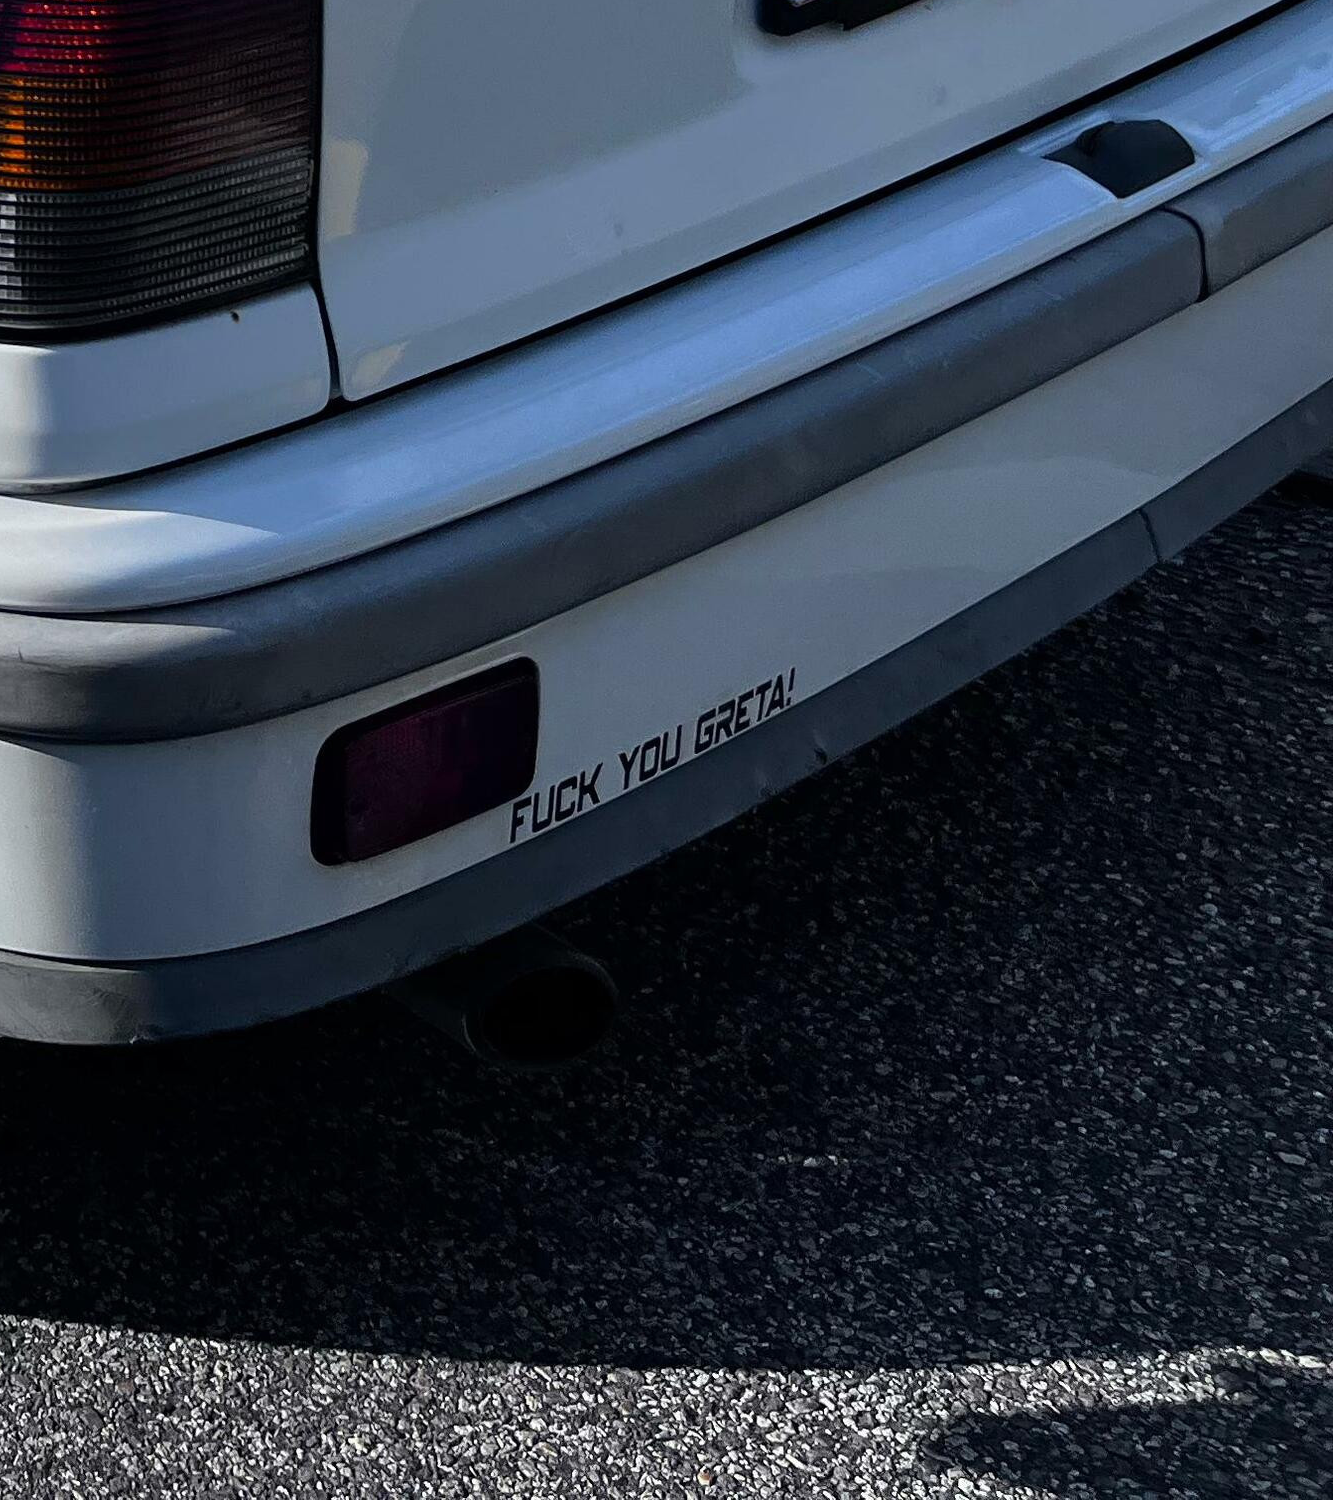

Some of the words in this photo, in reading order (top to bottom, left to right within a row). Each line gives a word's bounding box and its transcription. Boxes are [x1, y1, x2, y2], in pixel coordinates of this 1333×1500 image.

[510, 762, 604, 843] FUCK
[618, 724, 683, 790] YOU
[694, 666, 796, 754] GRETA!
